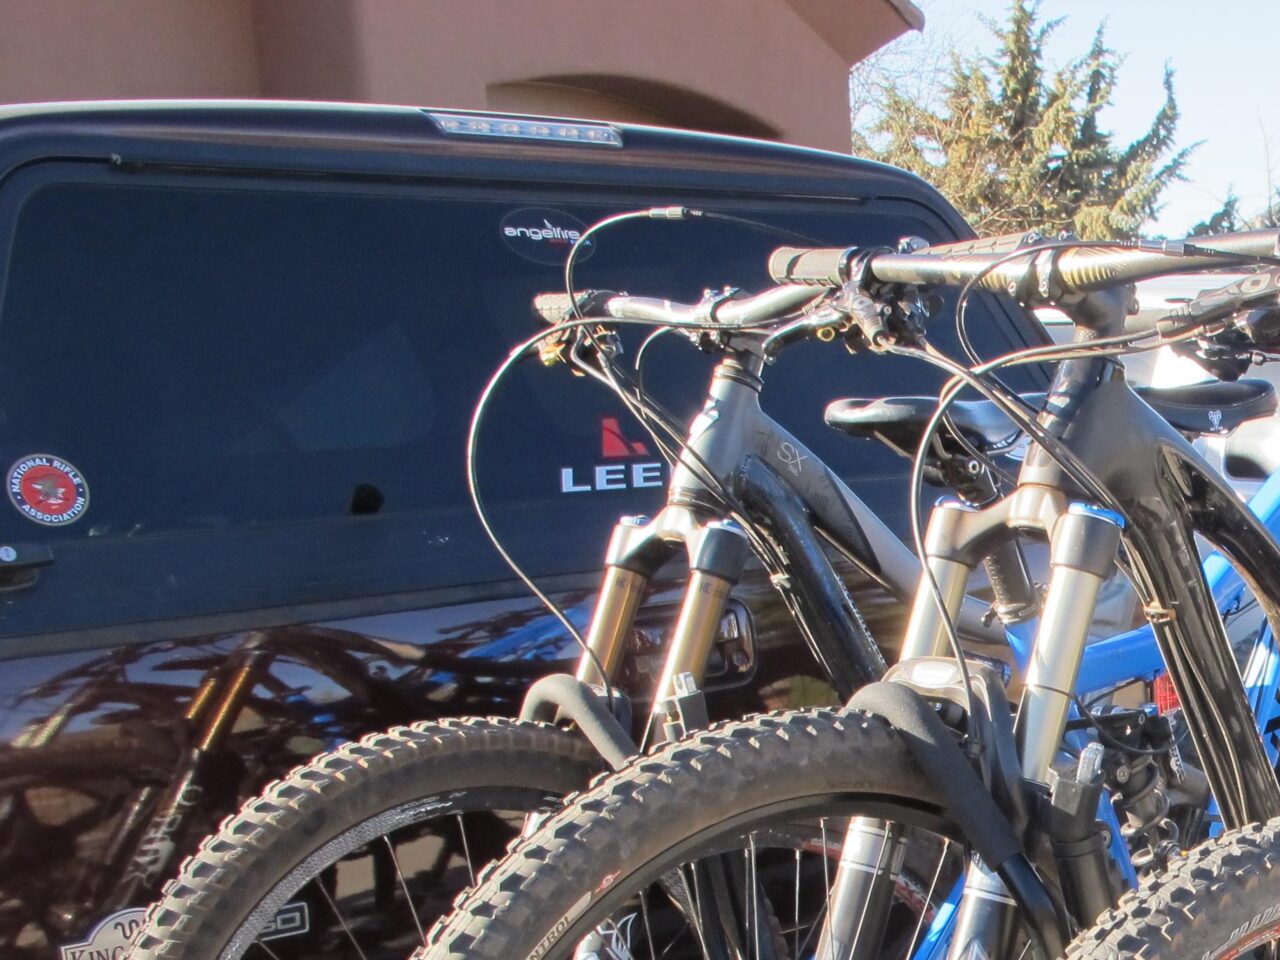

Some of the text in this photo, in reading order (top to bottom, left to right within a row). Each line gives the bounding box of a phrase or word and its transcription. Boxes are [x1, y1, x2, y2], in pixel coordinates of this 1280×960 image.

[503, 225, 580, 241] angelfire
[777, 442, 808, 472] SX
[11, 458, 82, 493] NATIONAL RIFLE
[561, 463, 672, 493] LEE
[21, 496, 86, 522] ASSOCIATION
